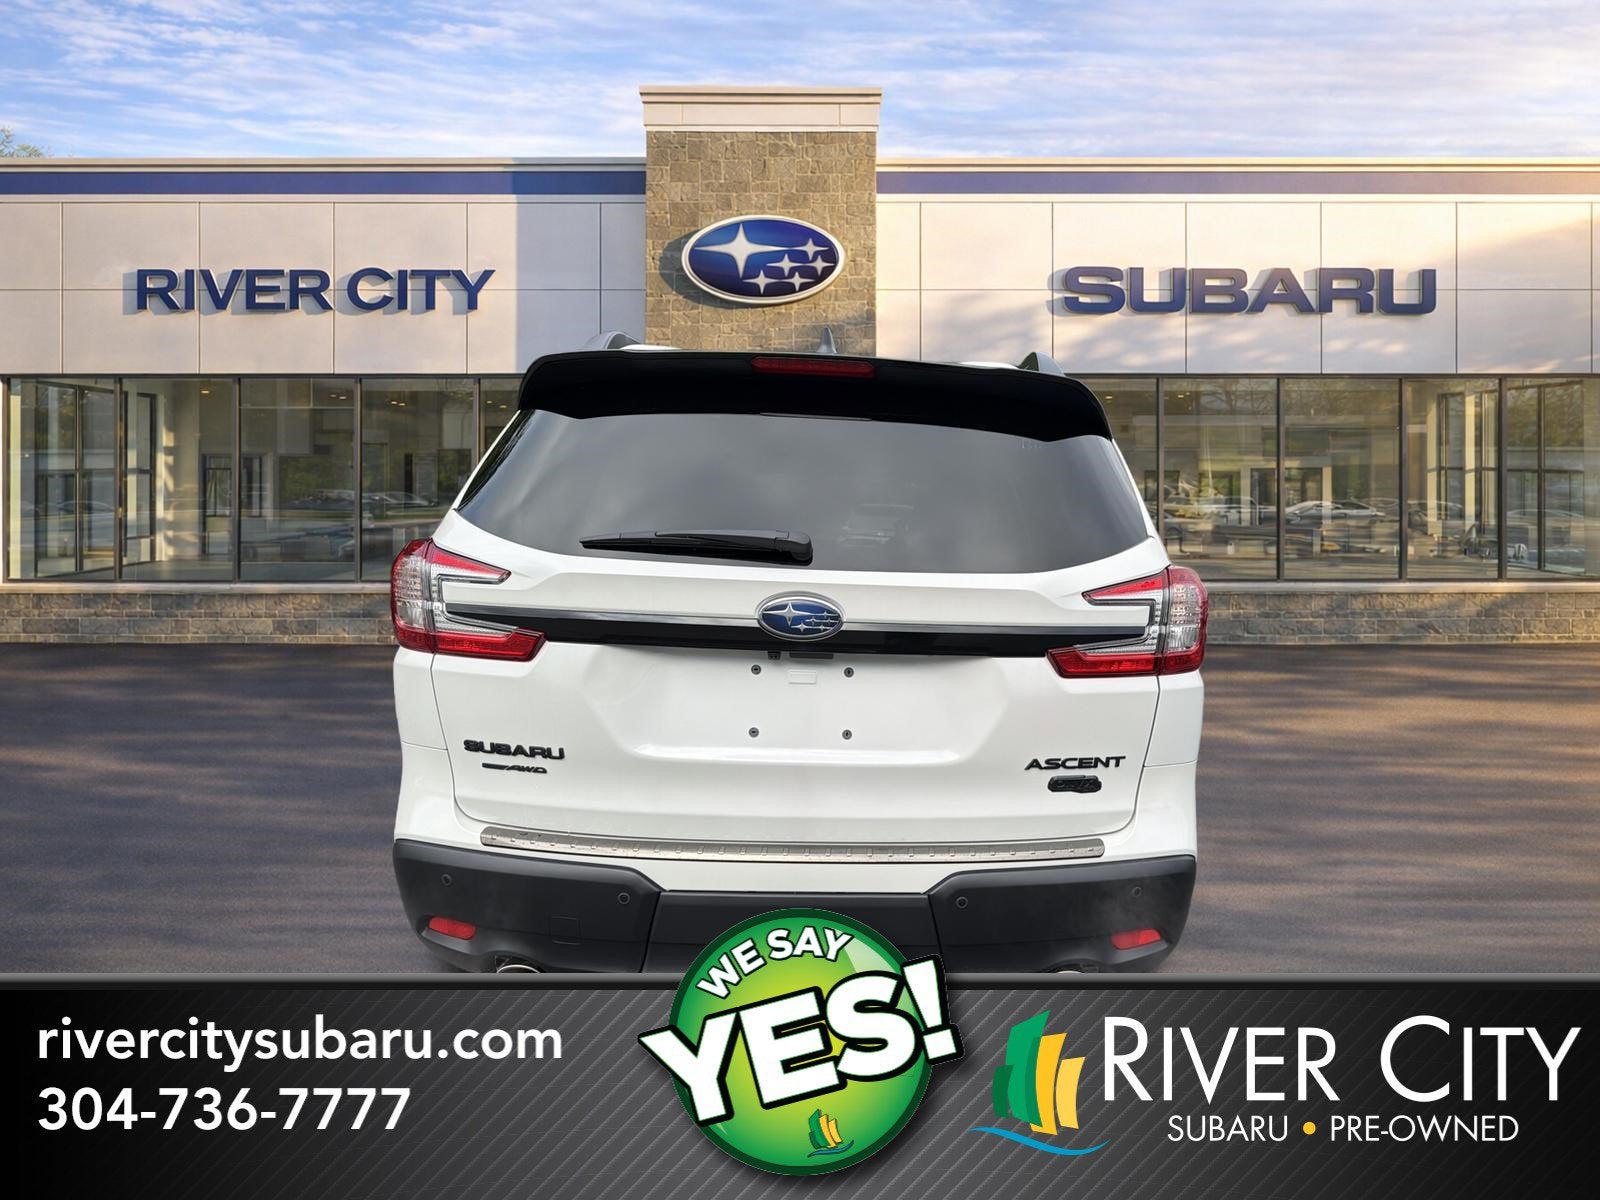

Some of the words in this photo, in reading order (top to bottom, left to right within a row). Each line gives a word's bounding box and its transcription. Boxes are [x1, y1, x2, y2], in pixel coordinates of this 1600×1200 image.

[136, 268, 334, 311] RIVER
[347, 267, 496, 311] CITY
[1062, 266, 1438, 315] SUBARU
[463, 739, 565, 760] SUBARU
[506, 764, 548, 774] AWD
[1024, 755, 1127, 771] ASCENT
